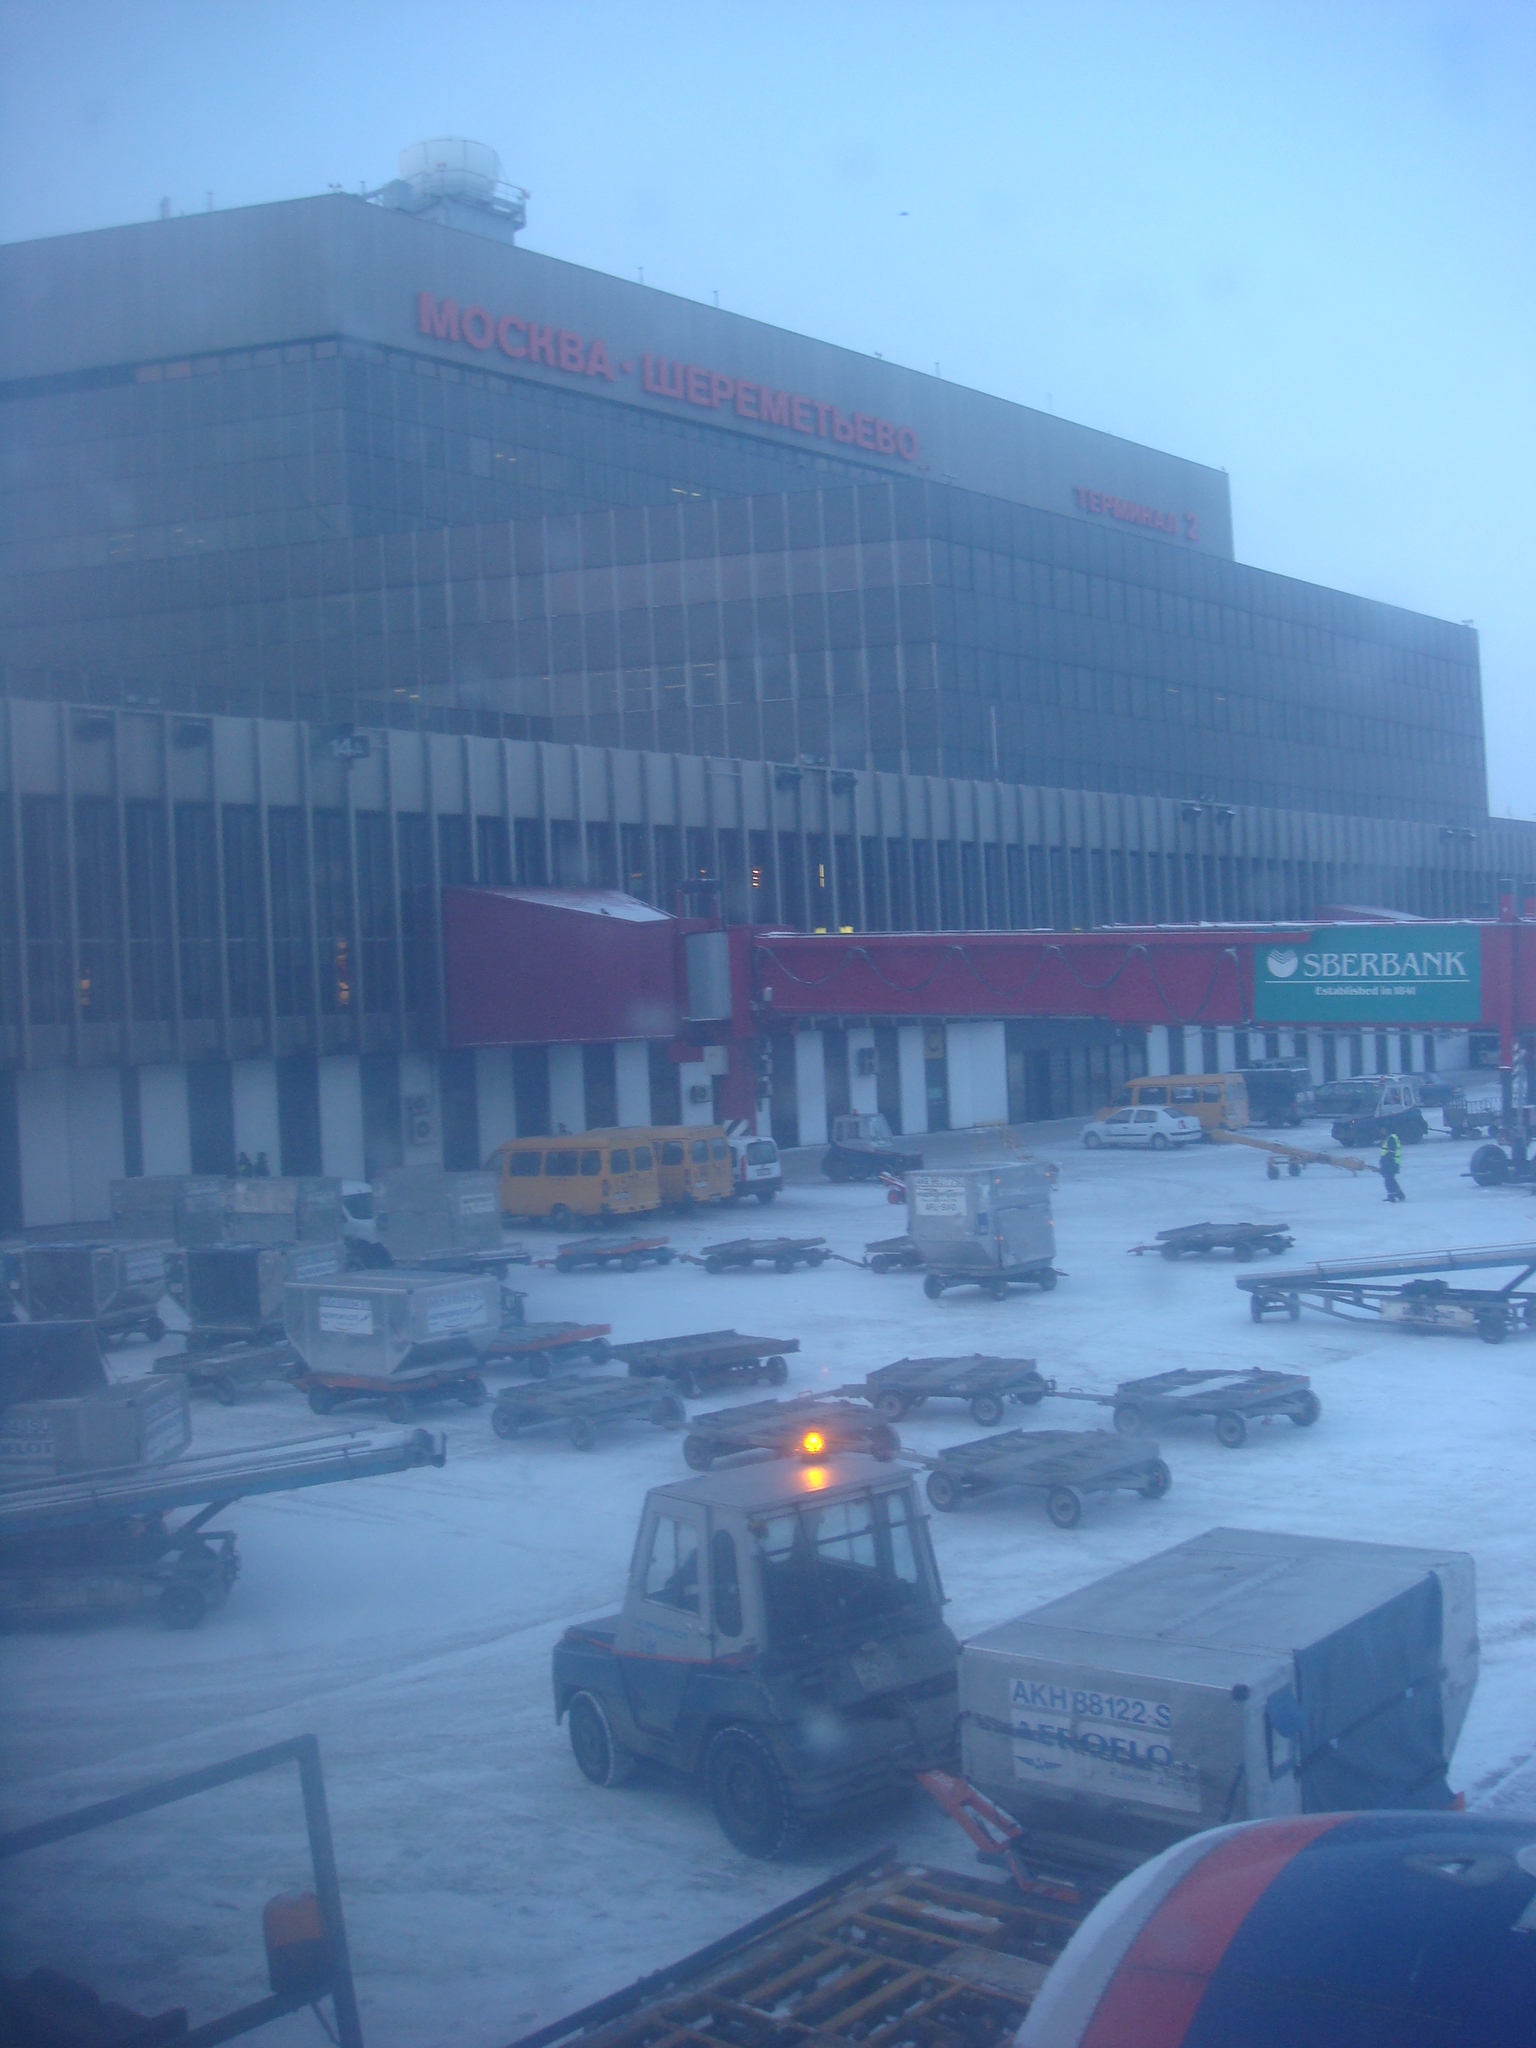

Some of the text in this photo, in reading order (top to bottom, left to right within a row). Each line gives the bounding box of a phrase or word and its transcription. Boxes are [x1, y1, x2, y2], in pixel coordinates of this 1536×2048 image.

[417, 291, 921, 462] МОСКВА ШЕРЕМЕТЬЕВО
[1303, 951, 1467, 977] SBERBANK
[1315, 986, 1417, 996] Established in 1841
[1012, 1680, 1067, 1709] AKH
[1073, 1690, 1146, 1724] 88122
